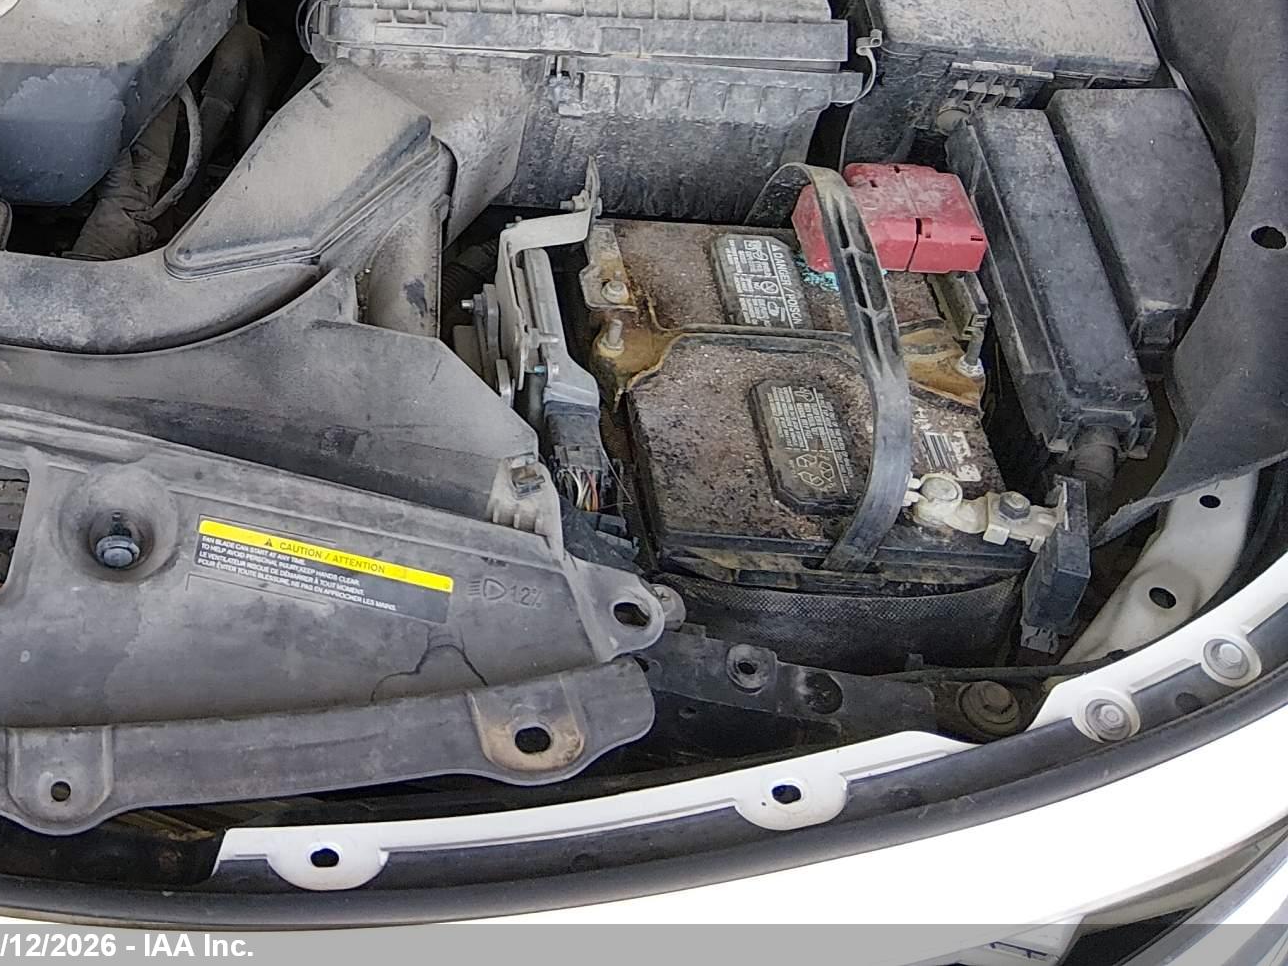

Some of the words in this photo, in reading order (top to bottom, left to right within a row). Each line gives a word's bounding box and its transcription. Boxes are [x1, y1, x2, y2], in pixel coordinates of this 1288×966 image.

[773, 252, 792, 286] DANGER
[279, 542, 321, 557] CAUTION
[332, 555, 385, 572] ATTENTION
